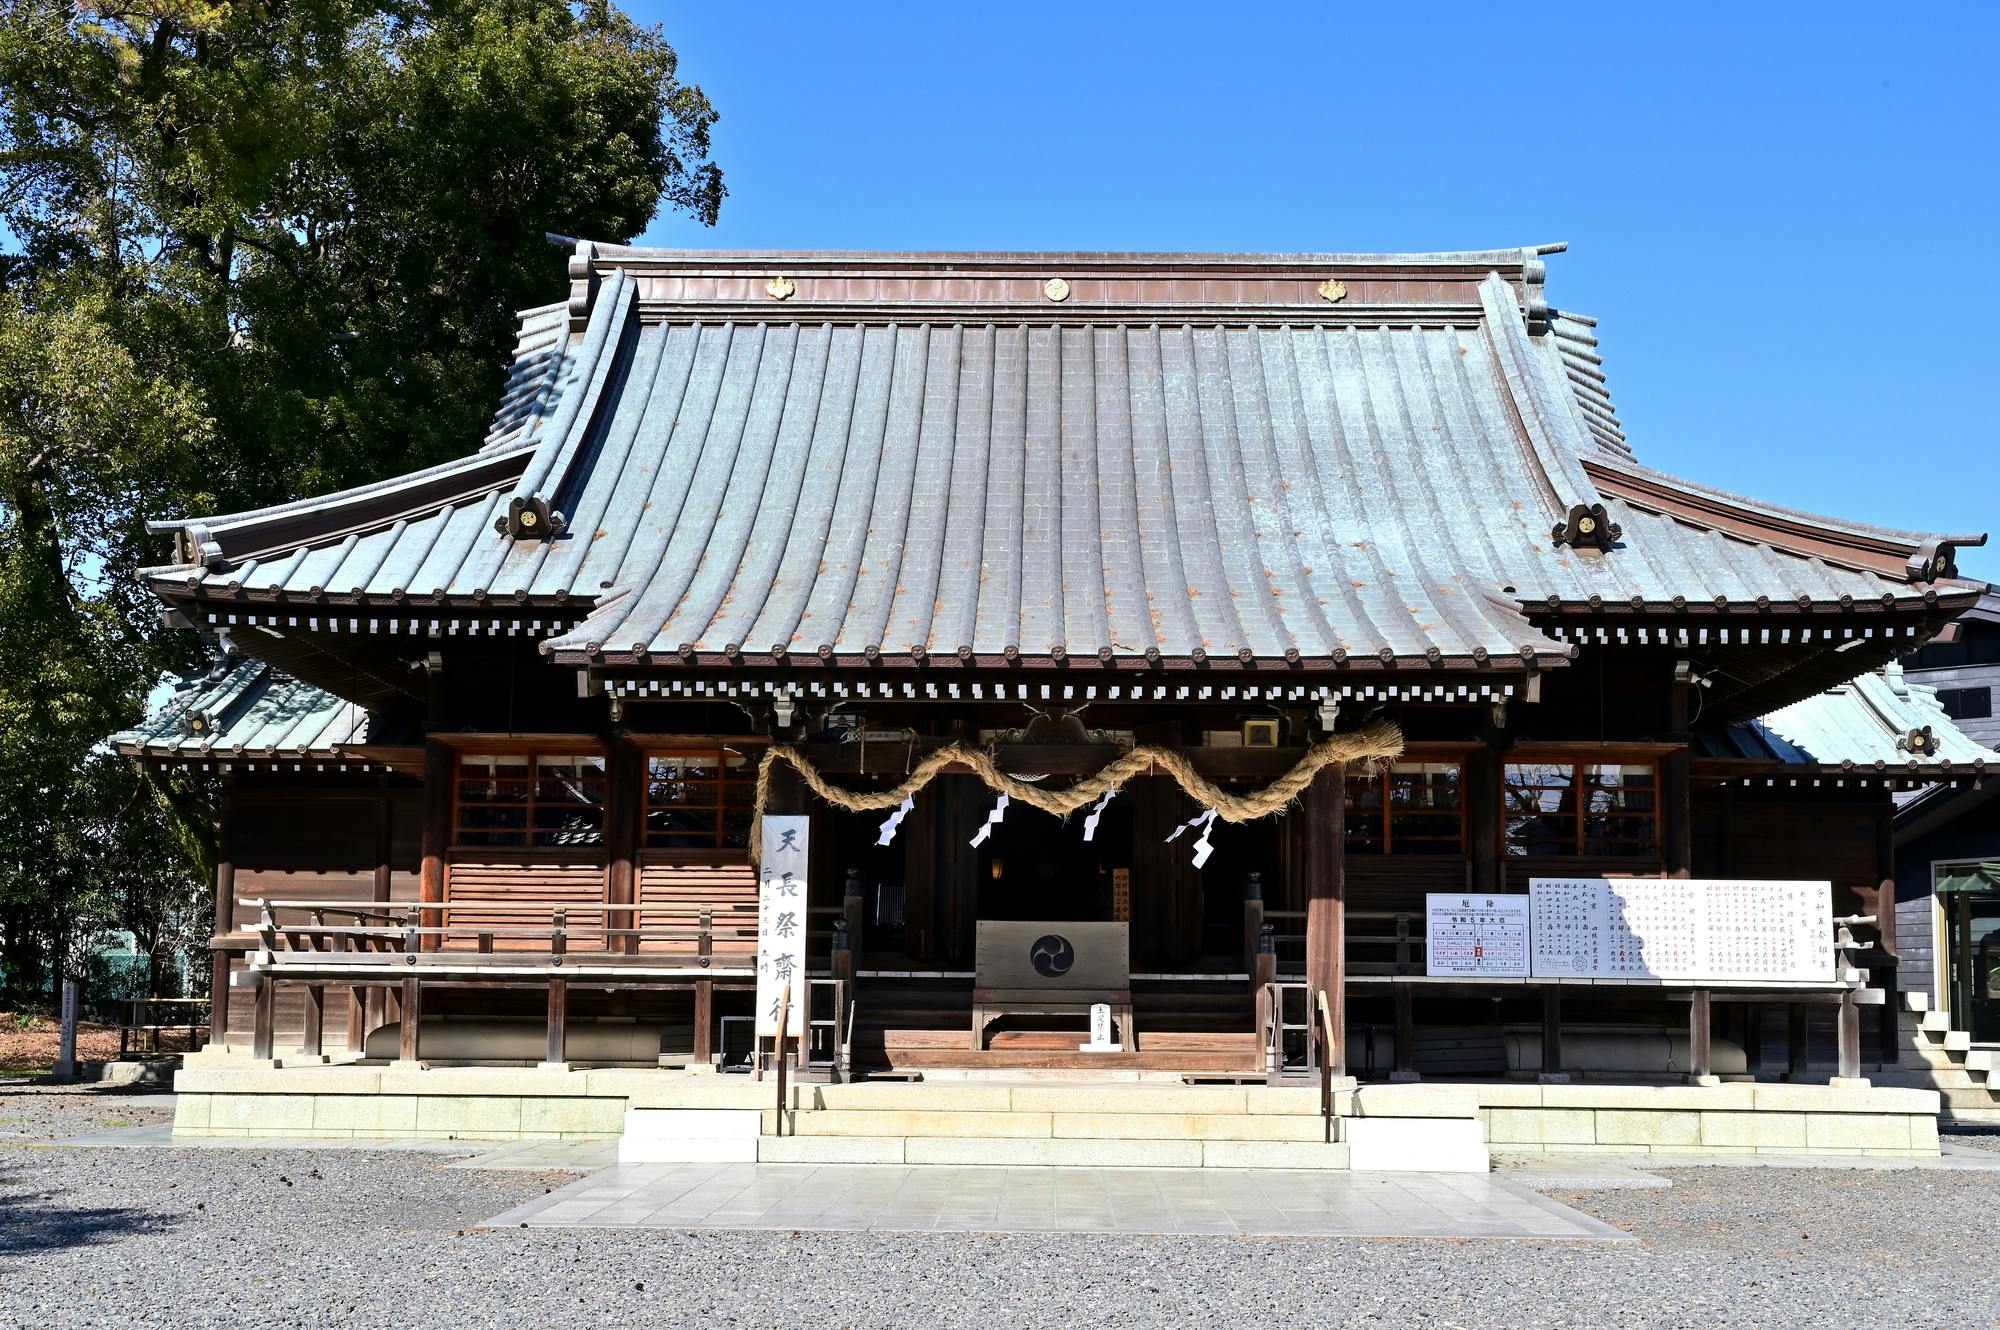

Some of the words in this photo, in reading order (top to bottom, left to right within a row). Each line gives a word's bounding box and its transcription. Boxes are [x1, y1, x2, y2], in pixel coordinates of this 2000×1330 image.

[761, 867, 773, 937] 二月二十三日
[1462, 899, 1494, 908] 厄除
